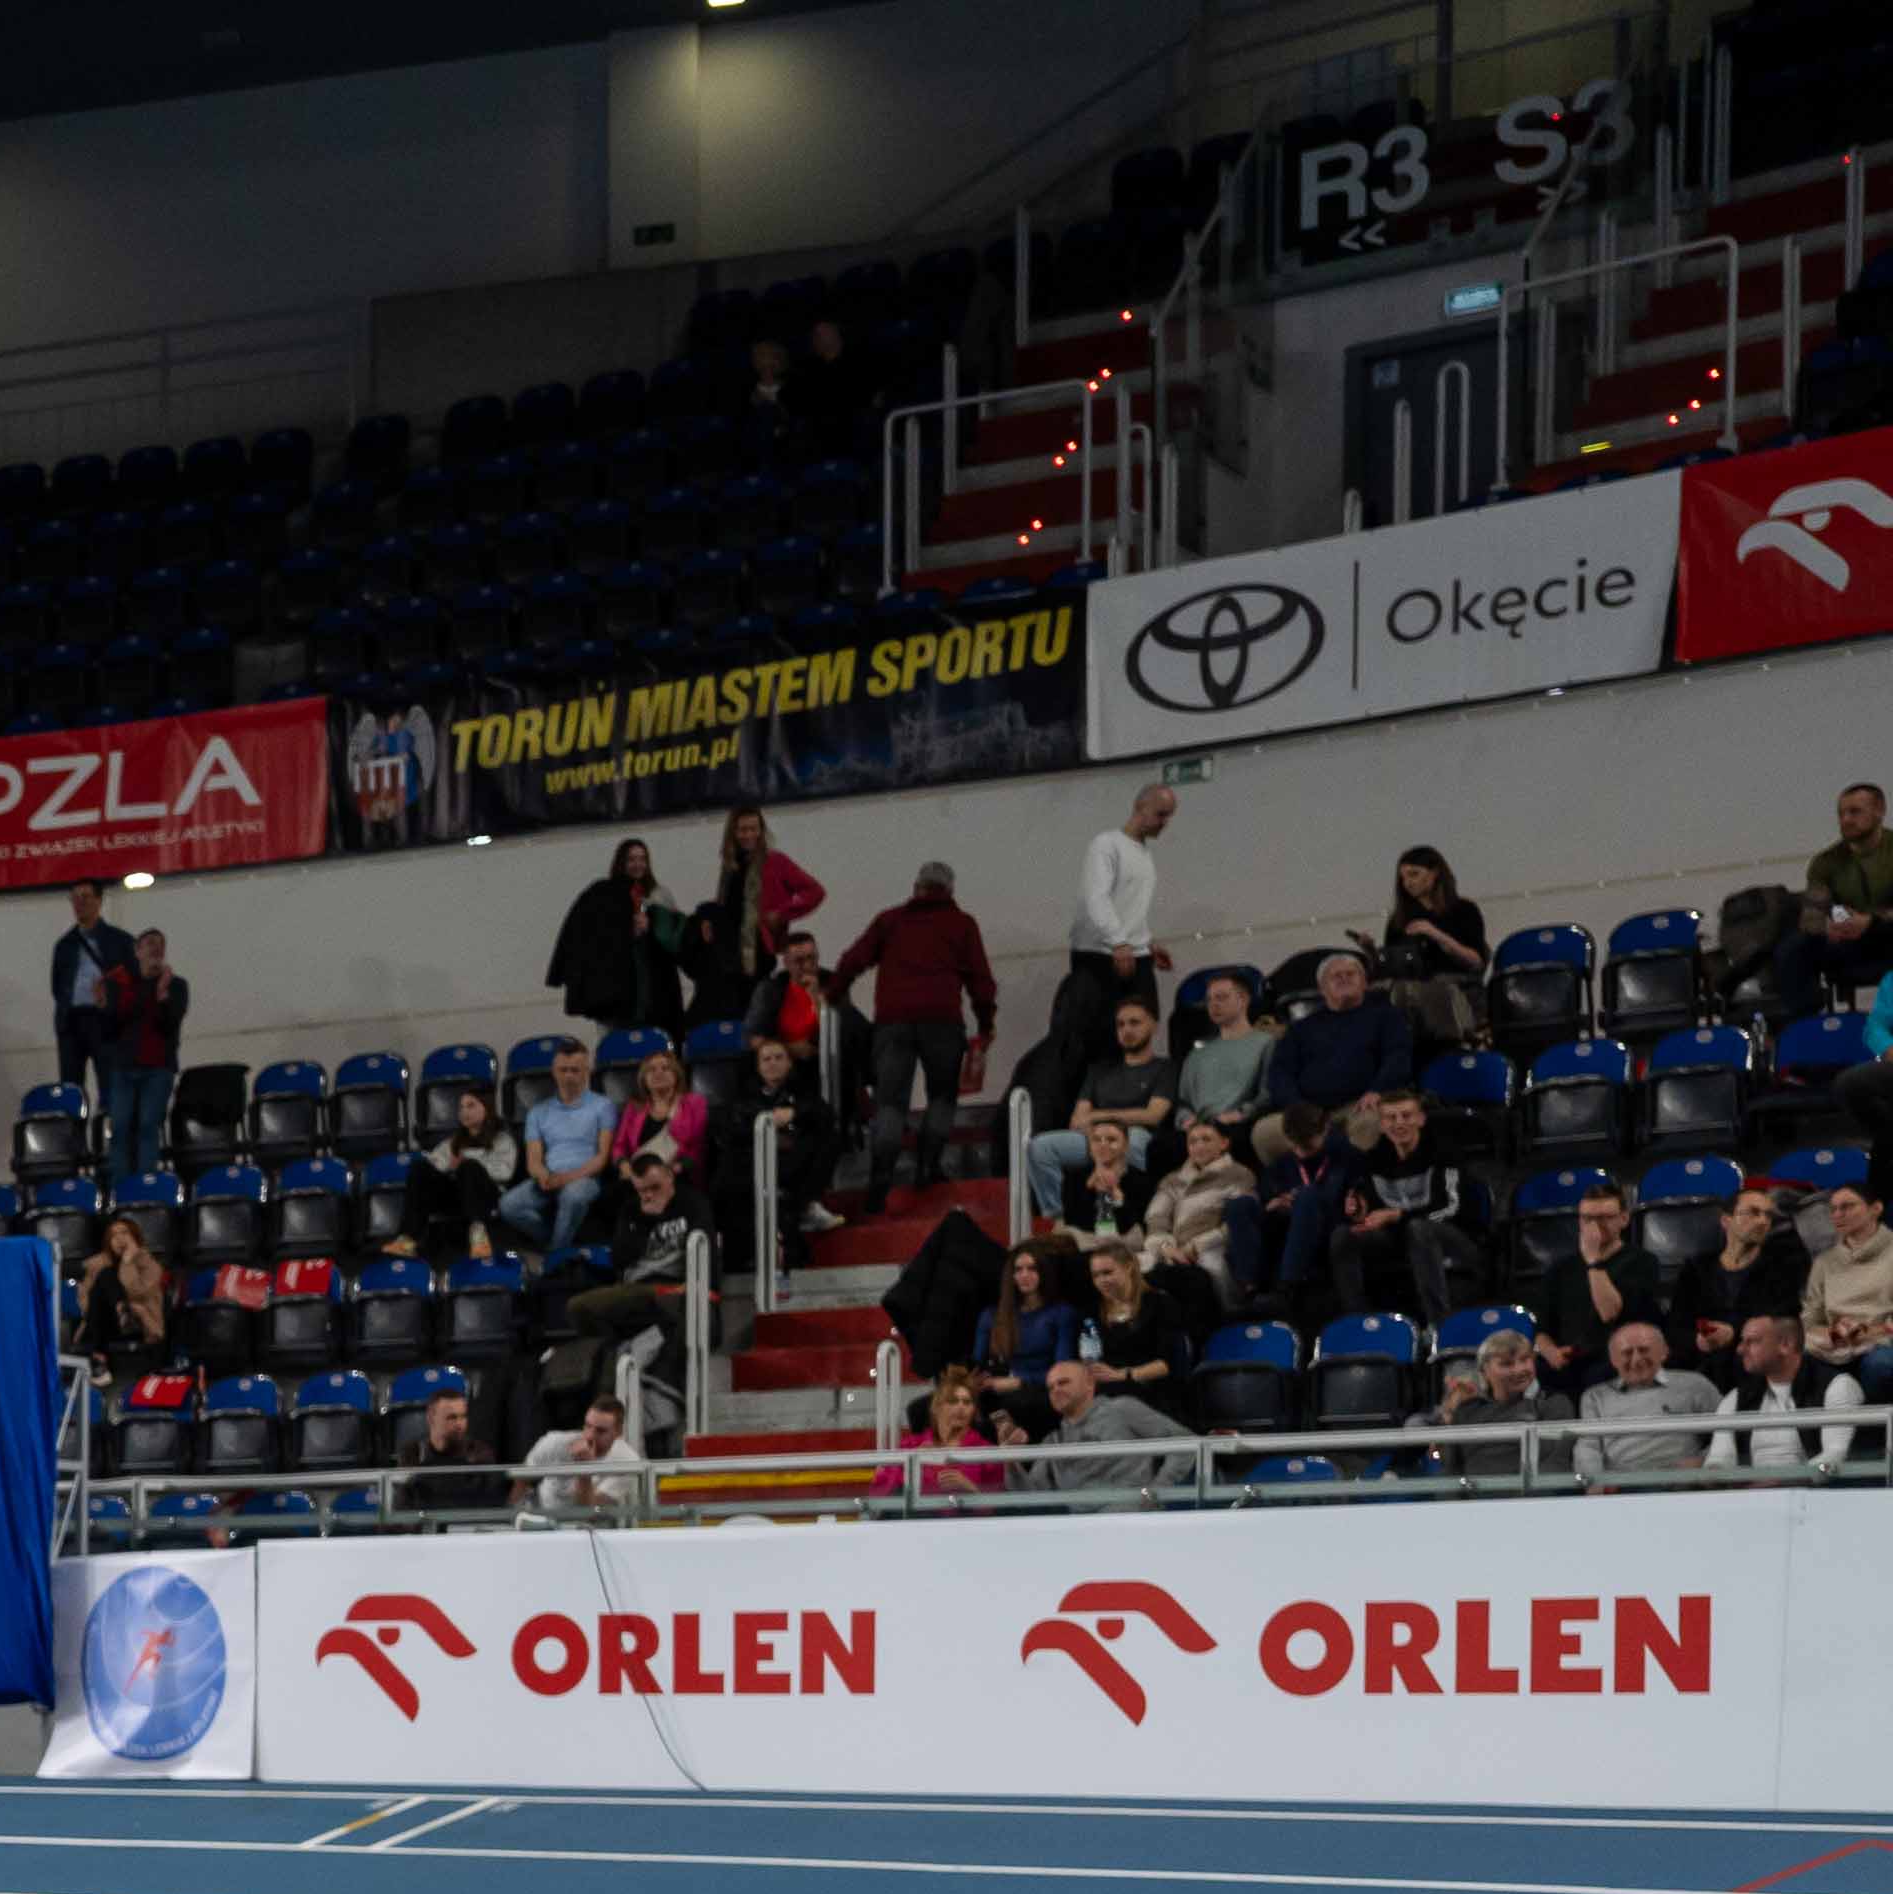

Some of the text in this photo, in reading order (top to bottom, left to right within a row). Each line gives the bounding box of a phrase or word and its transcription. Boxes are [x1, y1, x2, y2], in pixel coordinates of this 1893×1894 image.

[1299, 124, 1431, 231] R3
[1495, 79, 1634, 186] S3
[1386, 558, 1636, 645] Okęcie
[452, 606, 1073, 774] TORUŃ MIASTEM SPORTU
[545, 732, 741, 795] www.torun.pl
[511, 1610, 877, 1697] ORLEN
[1259, 1594, 1712, 1697] ORLEN
